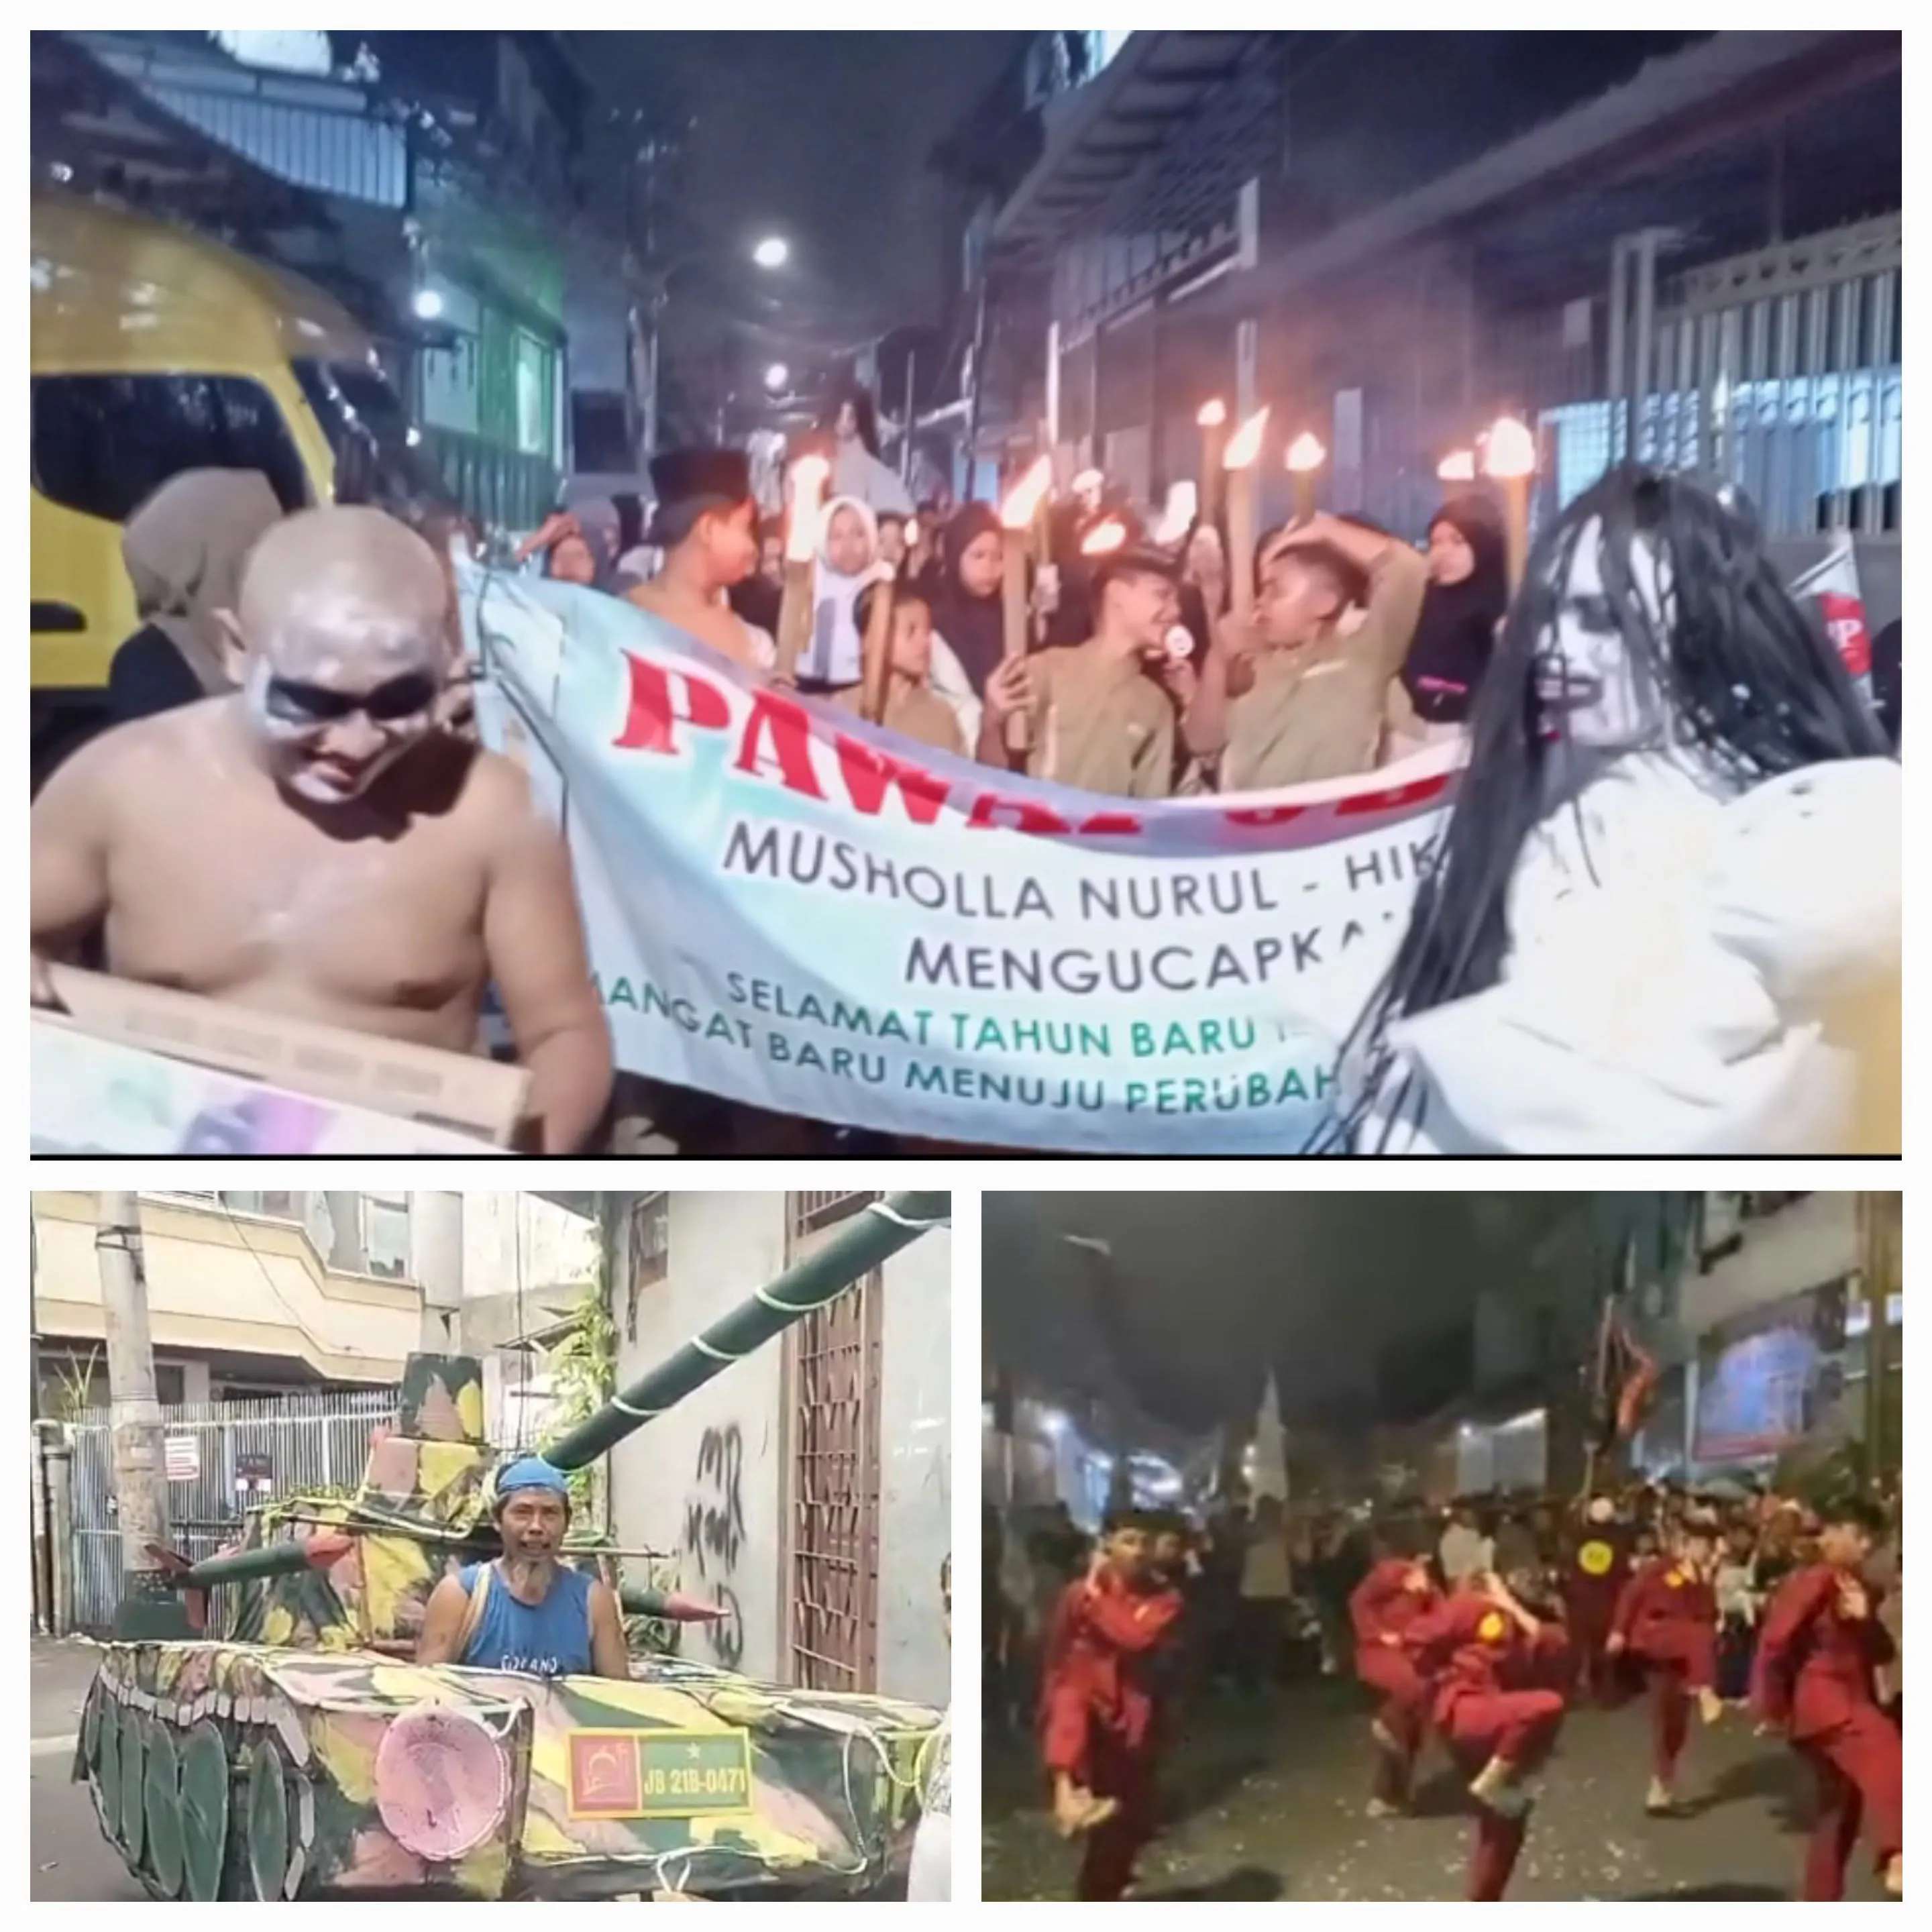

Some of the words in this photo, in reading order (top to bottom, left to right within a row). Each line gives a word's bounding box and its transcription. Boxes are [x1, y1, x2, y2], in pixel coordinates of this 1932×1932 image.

[723, 820, 1051, 920] MUSHOLLA
[1079, 868, 1279, 921] NURUL
[1344, 833, 1440, 892] HIK
[727, 971, 934, 1046] SELAMAT
[951, 1012, 1112, 1057] TAHUN
[1130, 1016, 1256, 1058] BARU
[767, 1032, 887, 1083] BARU
[904, 1061, 1105, 1112] MENUJU
[1124, 1065, 1340, 1114] PERUBAH
[644, 1768, 665, 1795] JB
